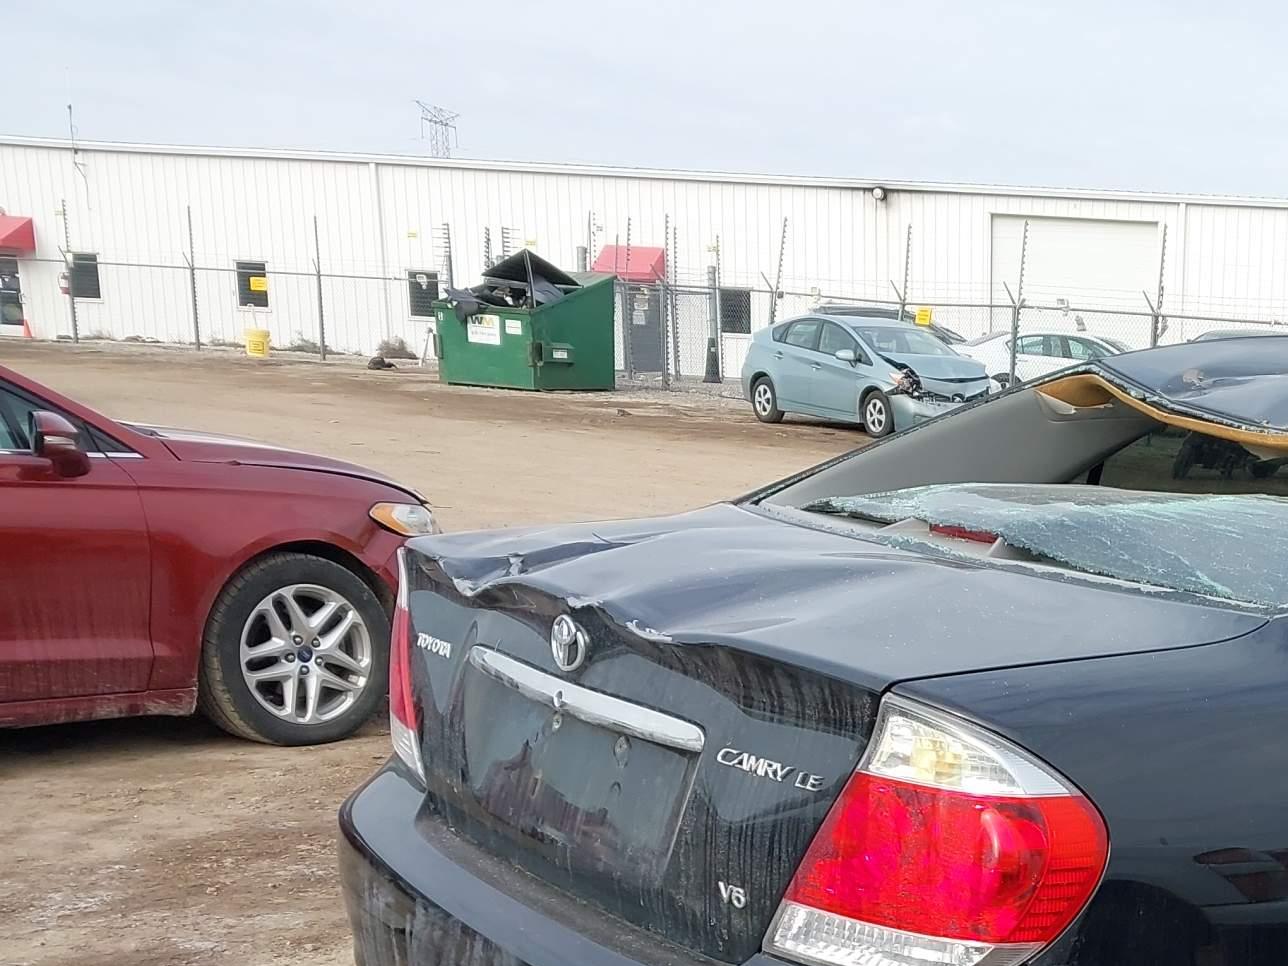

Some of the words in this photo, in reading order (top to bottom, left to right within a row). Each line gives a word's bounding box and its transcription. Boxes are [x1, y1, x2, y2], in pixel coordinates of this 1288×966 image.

[417, 632, 451, 659] TOYOTA
[716, 747, 795, 782] CAMRY
[794, 771, 825, 792] LE
[718, 880, 747, 909] V6
